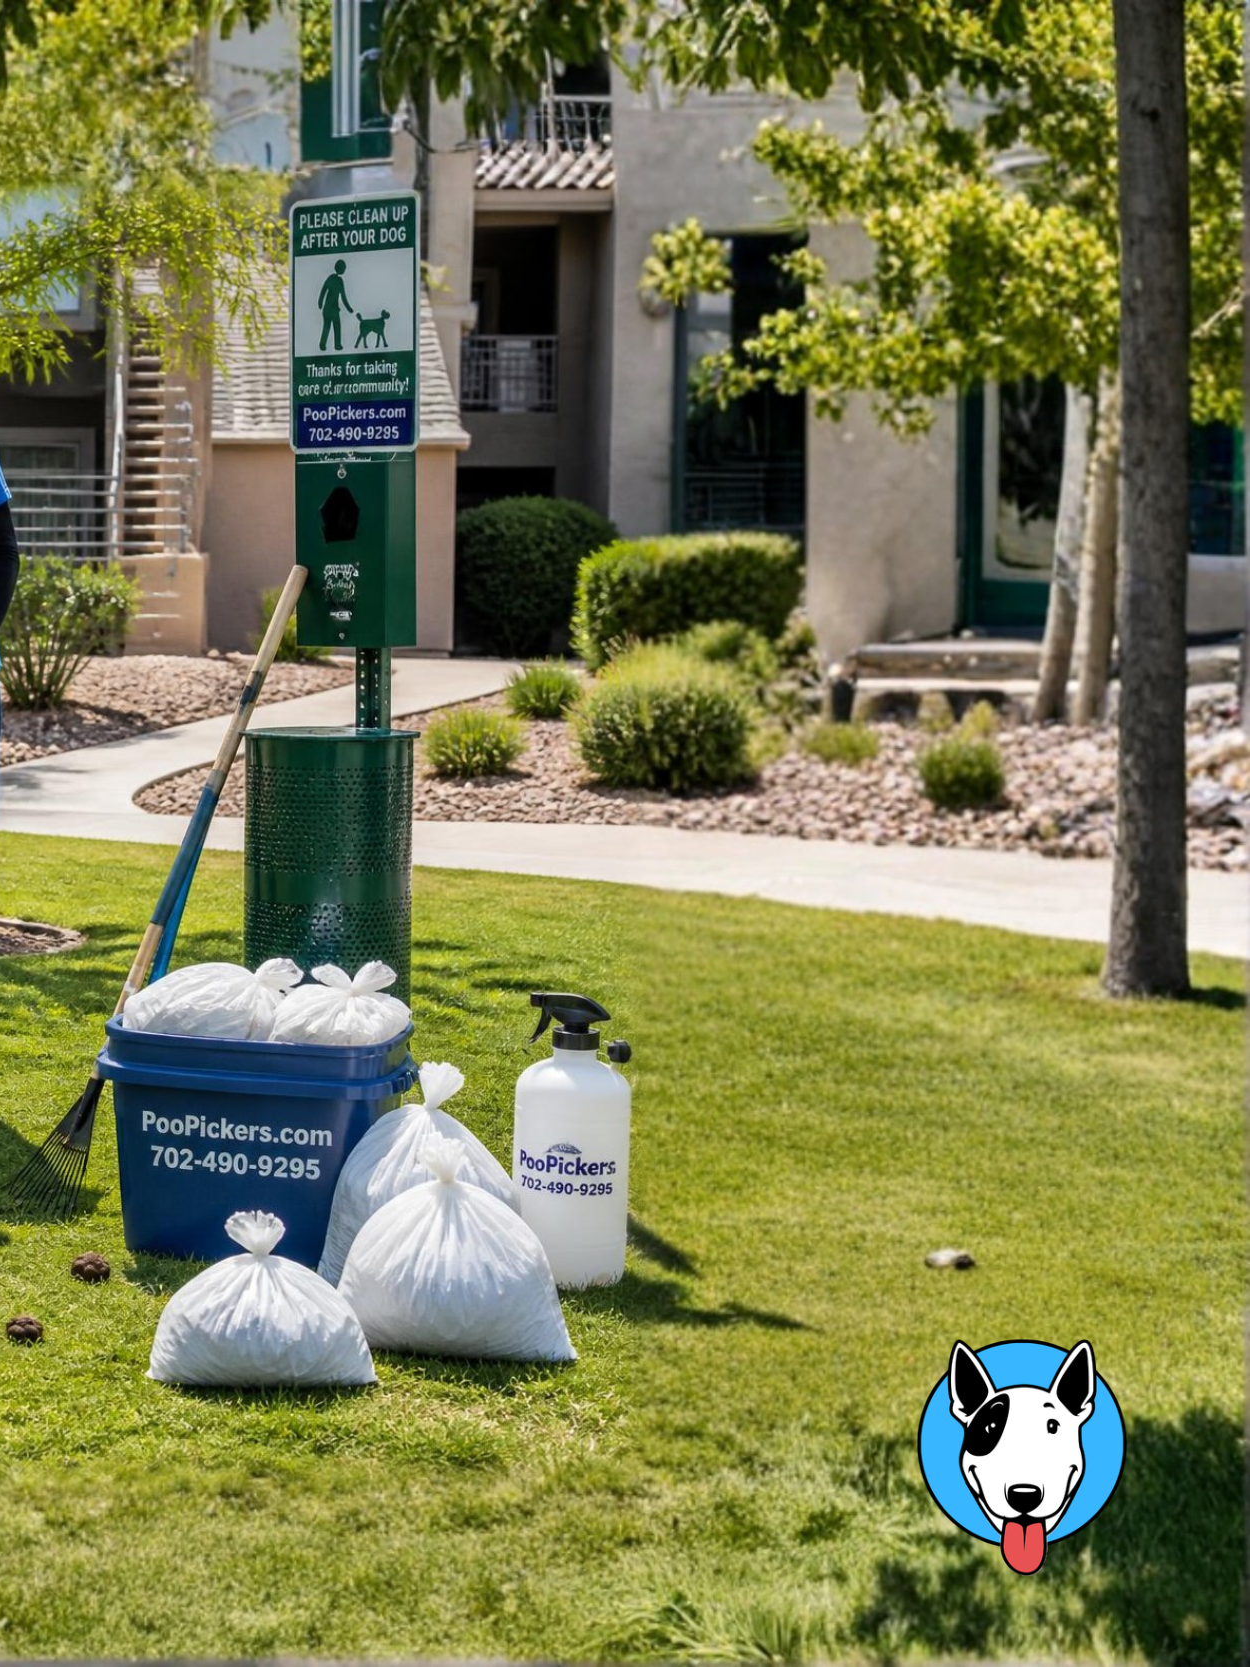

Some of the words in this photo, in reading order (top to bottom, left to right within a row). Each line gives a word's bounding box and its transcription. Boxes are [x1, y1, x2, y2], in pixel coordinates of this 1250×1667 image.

[299, 211, 344, 230] PLEASE
[348, 207, 388, 225] CLEAN
[392, 205, 409, 222] UP
[300, 232, 338, 249] AFTER
[342, 229, 375, 246] YOUR
[380, 226, 407, 244] DOG
[306, 363, 342, 377] Thanks
[345, 361, 361, 376] for
[364, 360, 398, 376] taking
[298, 384, 320, 397] care
[303, 405, 407, 422] PooPickers.com
[142, 1110, 333, 1147] PooPickers.com
[150, 1145, 321, 1181] 702-490-9295
[520, 1149, 616, 1176] PooPickers
[521, 1175, 613, 1196] 702-490-9295
